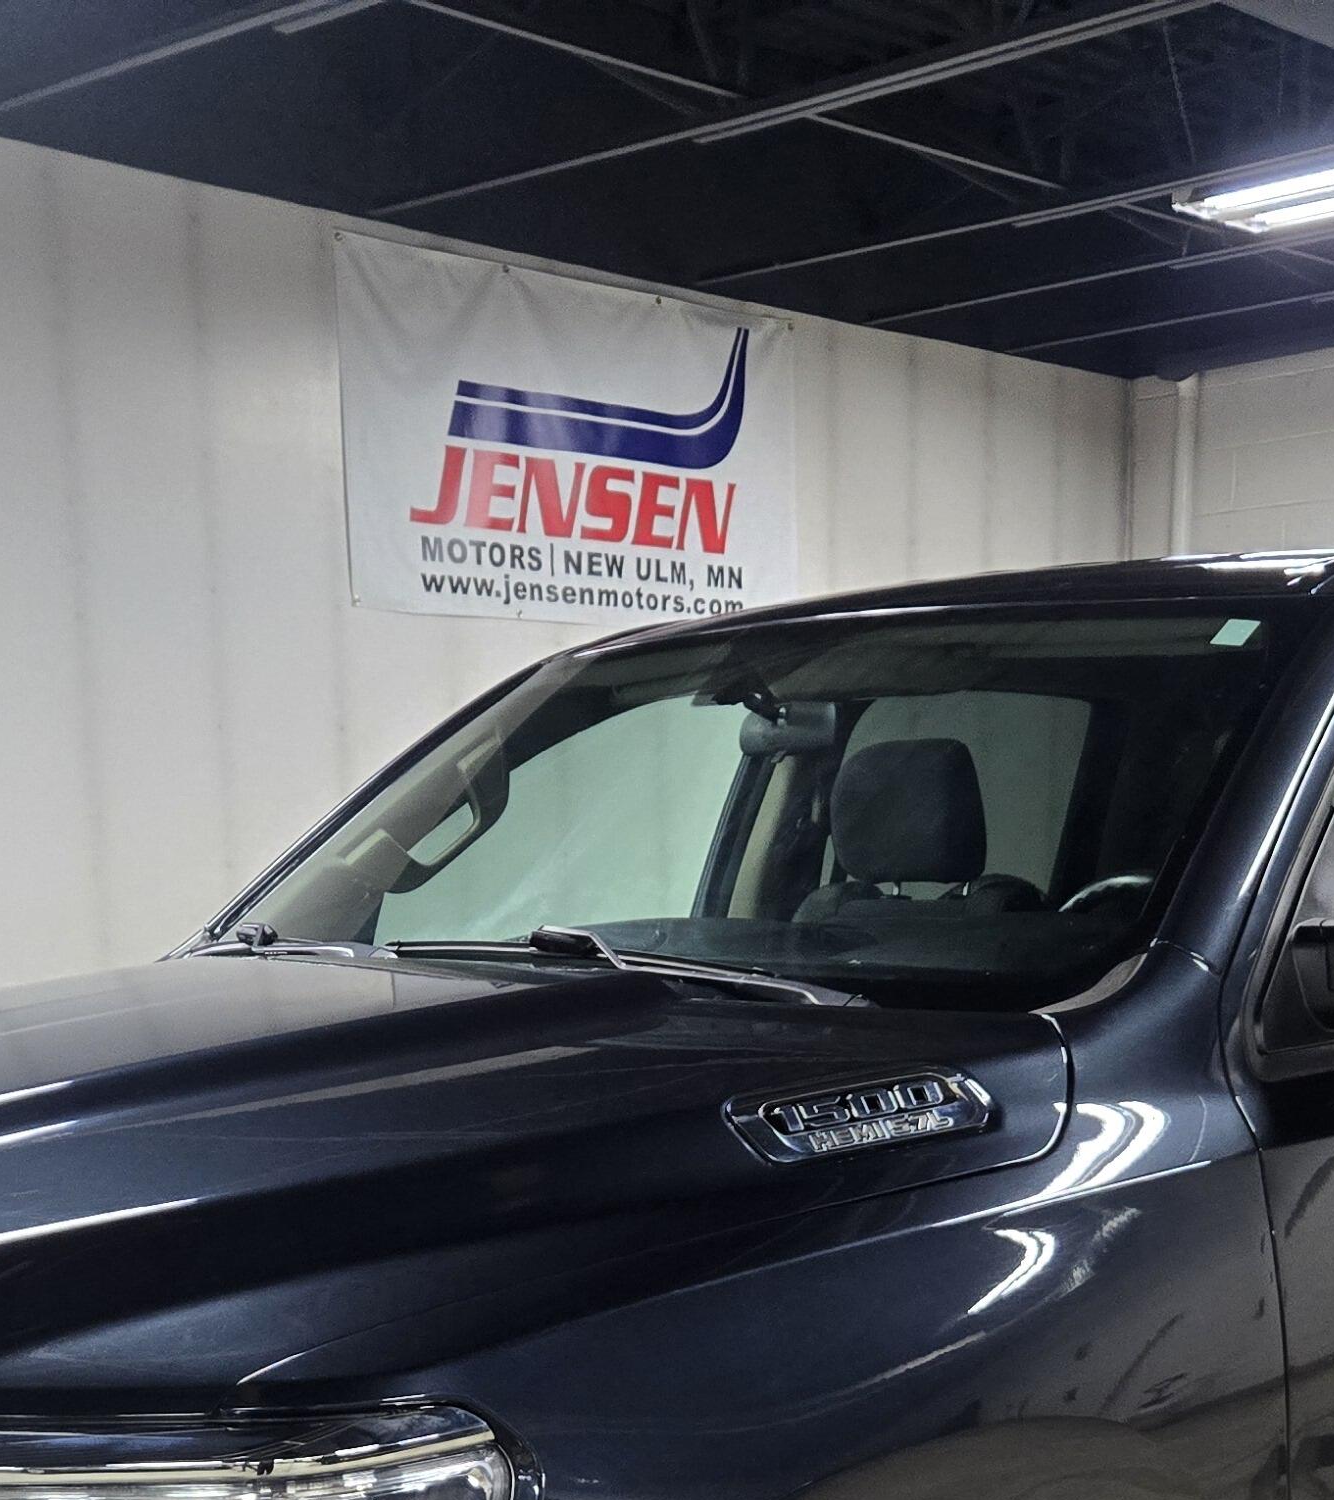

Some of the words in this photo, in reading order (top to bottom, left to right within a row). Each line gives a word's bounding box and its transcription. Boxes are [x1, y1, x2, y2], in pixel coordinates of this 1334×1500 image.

[410, 445, 736, 554] JENSEN
[420, 535, 543, 572] MOTORS
[564, 550, 624, 579] NEW
[636, 556, 694, 591] ULM,
[707, 564, 744, 589] MN
[420, 572, 744, 615] www.jensenmotors.com
[771, 1080, 944, 1132] 1500
[809, 1119, 890, 1151] HEMI
